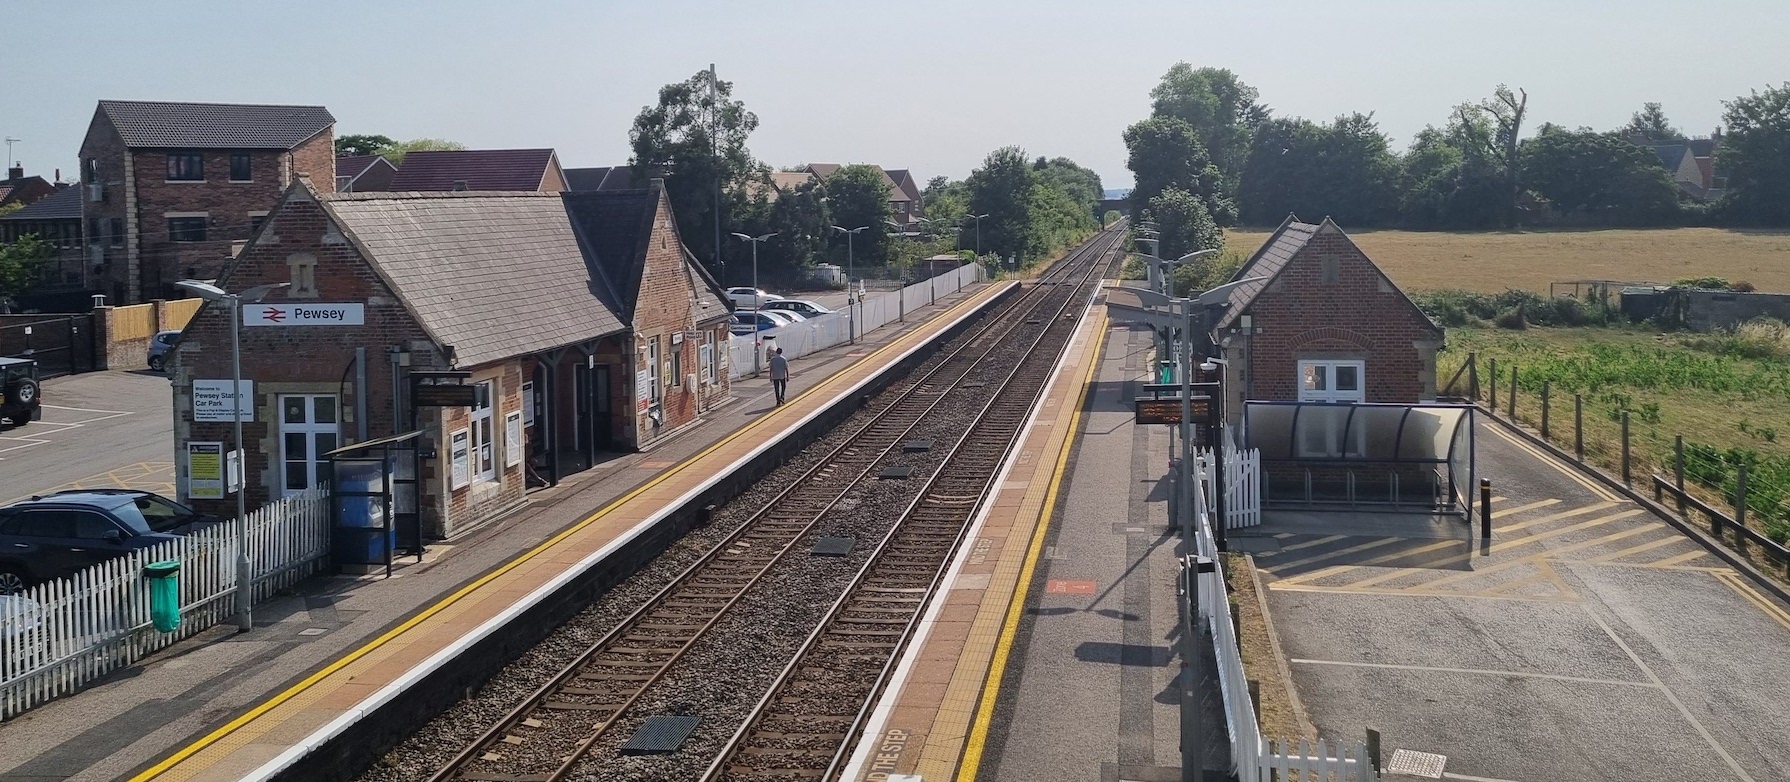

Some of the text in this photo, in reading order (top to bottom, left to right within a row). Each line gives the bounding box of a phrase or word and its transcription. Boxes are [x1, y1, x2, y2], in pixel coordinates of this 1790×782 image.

[294, 308, 345, 320] Pewsey
[881, 729, 908, 752] STEP
[872, 753, 899, 770] THE
